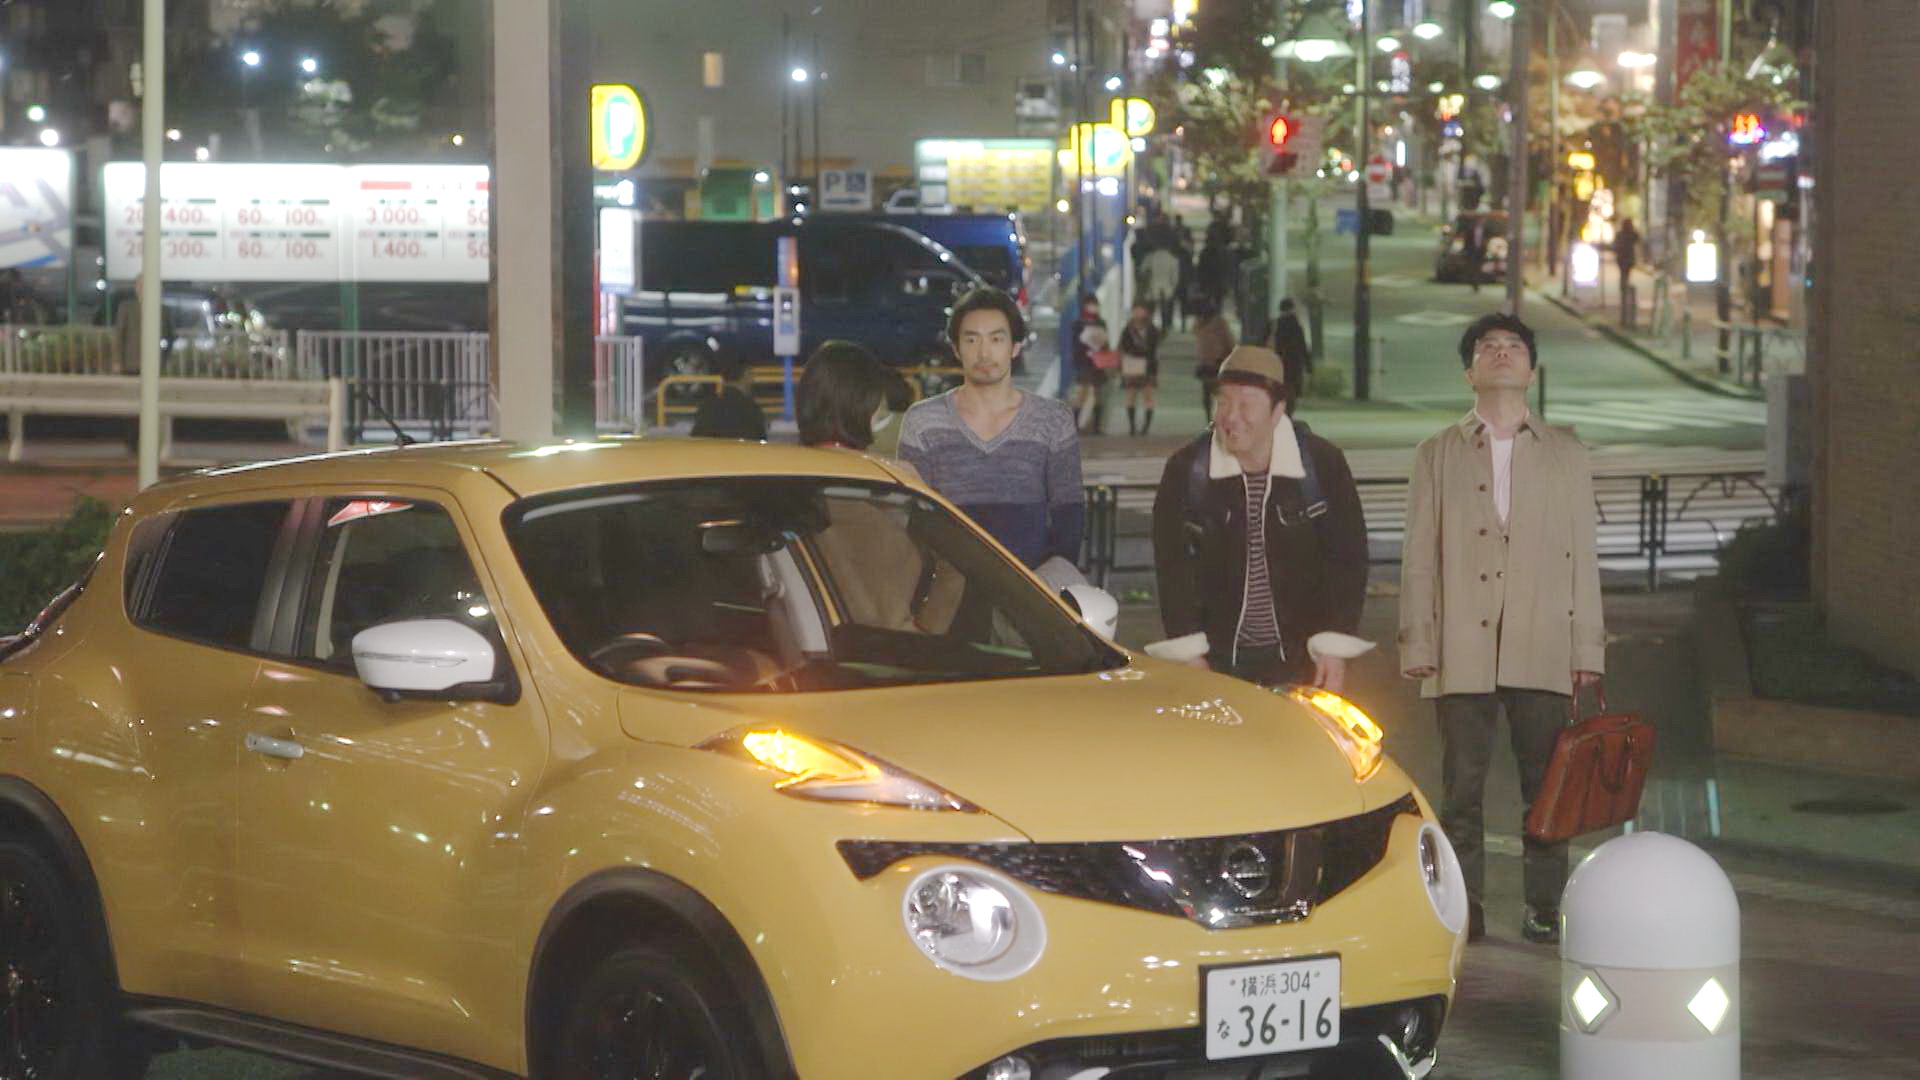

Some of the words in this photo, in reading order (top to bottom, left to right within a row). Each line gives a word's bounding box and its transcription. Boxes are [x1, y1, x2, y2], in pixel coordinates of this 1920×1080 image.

[609, 101, 635, 156] P
[1217, 1018, 1230, 1040] な
[1238, 996, 1332, 1048] 36-16
